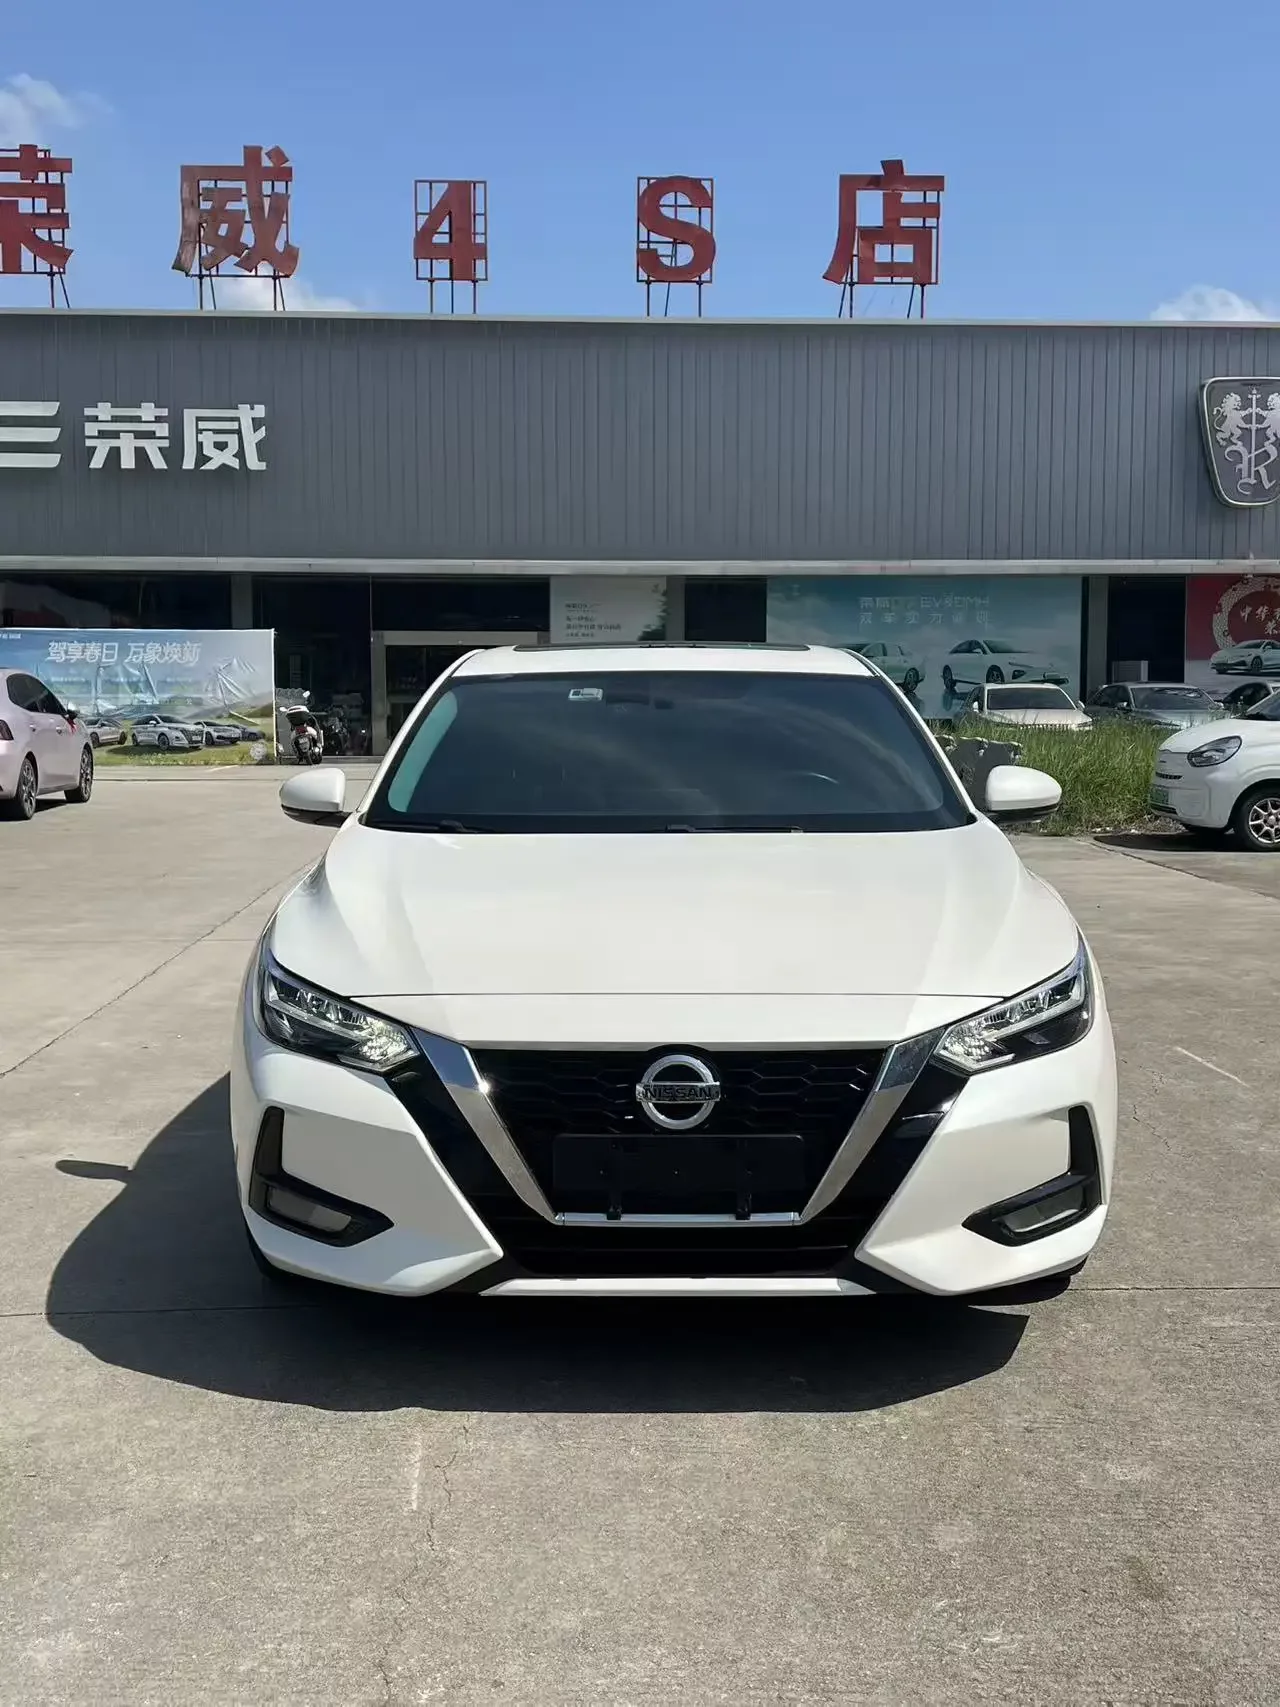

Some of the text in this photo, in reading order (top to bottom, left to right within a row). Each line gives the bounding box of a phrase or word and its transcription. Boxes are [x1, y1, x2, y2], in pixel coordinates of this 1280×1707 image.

[84, 402, 267, 470] 荣威
[46, 641, 201, 665] 驾享春日 万象焕新
[643, 1086, 712, 1100] NISSAN
